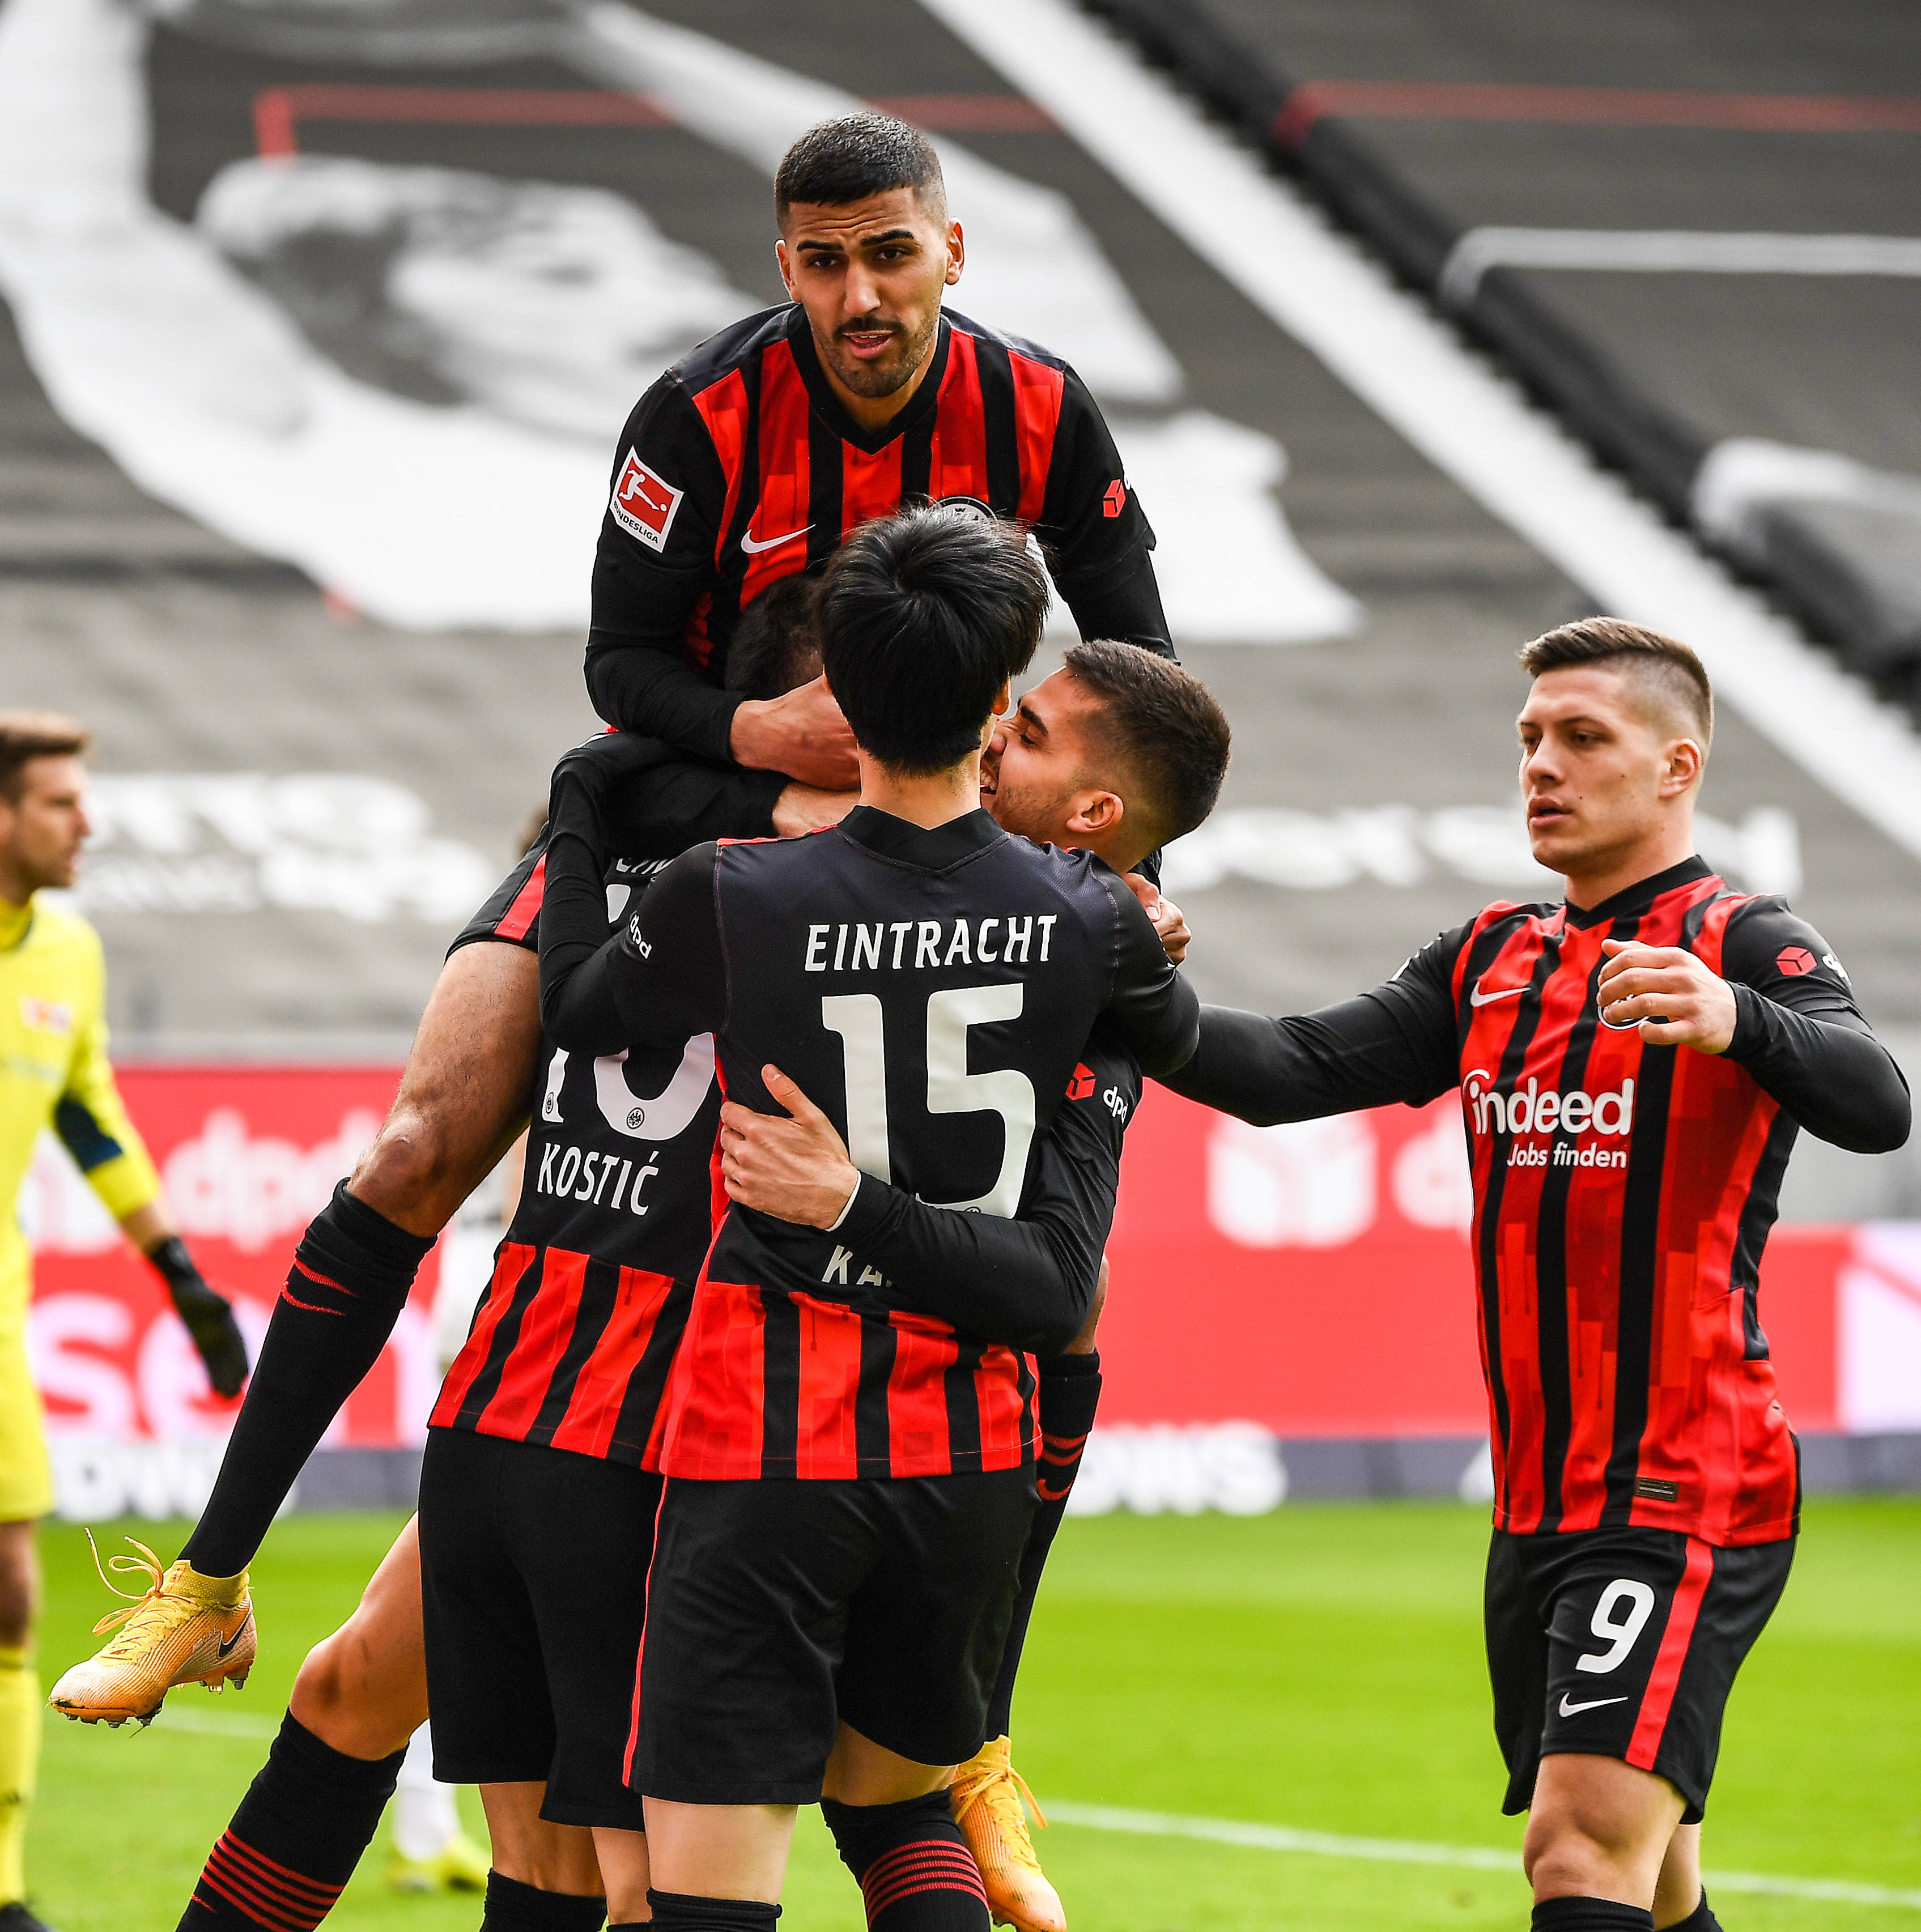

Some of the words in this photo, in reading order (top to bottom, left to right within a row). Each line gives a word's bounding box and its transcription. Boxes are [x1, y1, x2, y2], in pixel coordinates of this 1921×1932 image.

[614, 500, 658, 544] BUNDESLIGA
[804, 914, 1057, 971] EINTRACHT
[821, 982, 1036, 1219] 15
[1462, 1069, 1635, 1136] indeed
[537, 1142, 659, 1216] KOSTIĆ
[1506, 1141, 1549, 1167] Jobs
[1553, 1140, 1627, 1168] finden
[1575, 1578, 1655, 1674] 9
